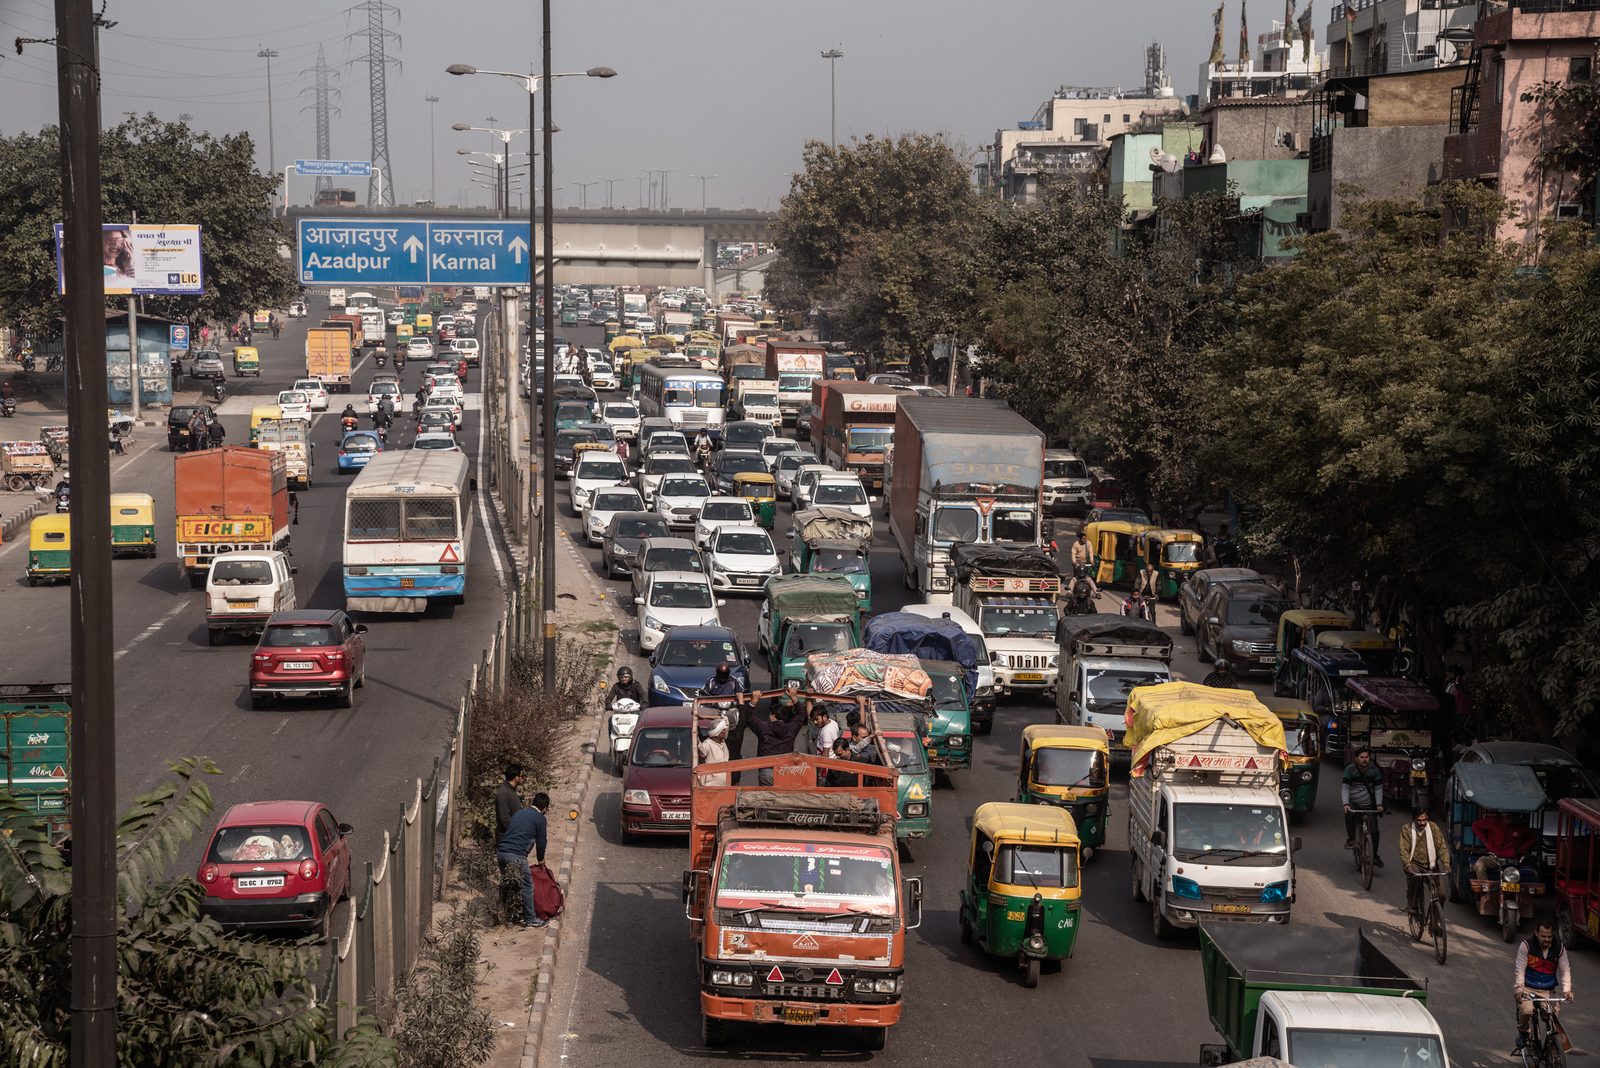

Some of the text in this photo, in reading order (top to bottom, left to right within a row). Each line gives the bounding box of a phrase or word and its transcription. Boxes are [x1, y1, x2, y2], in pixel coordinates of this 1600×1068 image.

[305, 227, 399, 252] आज़ादपुर
[432, 229, 504, 246] करनाल
[306, 252, 391, 273] Azadpur
[432, 253, 497, 270] Karnal
[181, 273, 197, 283] LIC
[1057, 918, 1074, 929] CNG
[767, 984, 839, 998] EICHER
